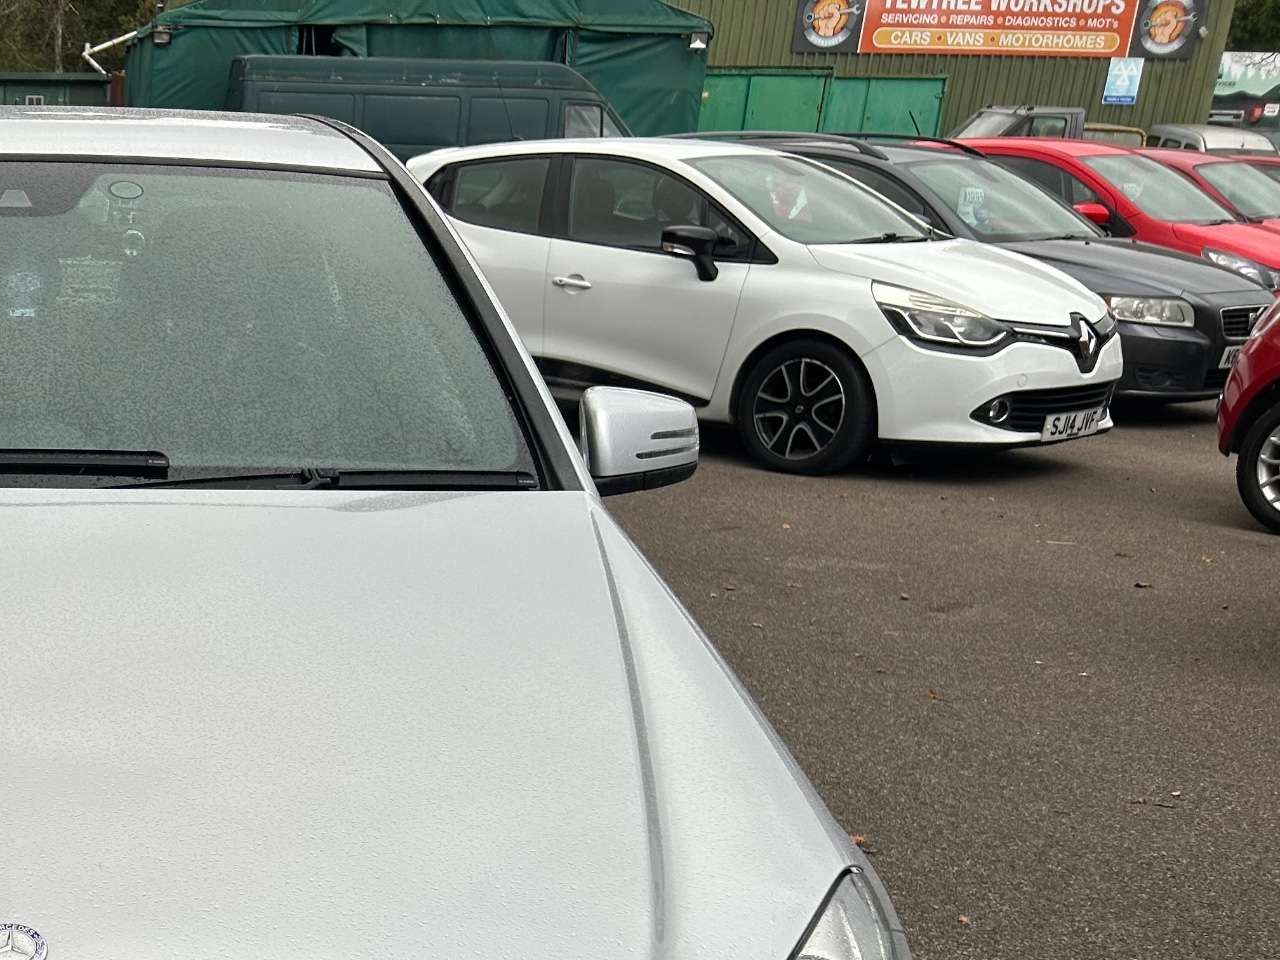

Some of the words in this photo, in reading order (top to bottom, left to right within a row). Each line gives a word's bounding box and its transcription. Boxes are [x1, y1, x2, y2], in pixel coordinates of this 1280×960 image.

[880, 12, 939, 24] SERVICING
[948, 14, 995, 26] REPAIRS
[1004, 15, 1078, 28] DIAGNOSTICS
[890, 31, 931, 45] CARS
[946, 32, 985, 46] VANS
[998, 33, 1105, 49] MOTORHOMES
